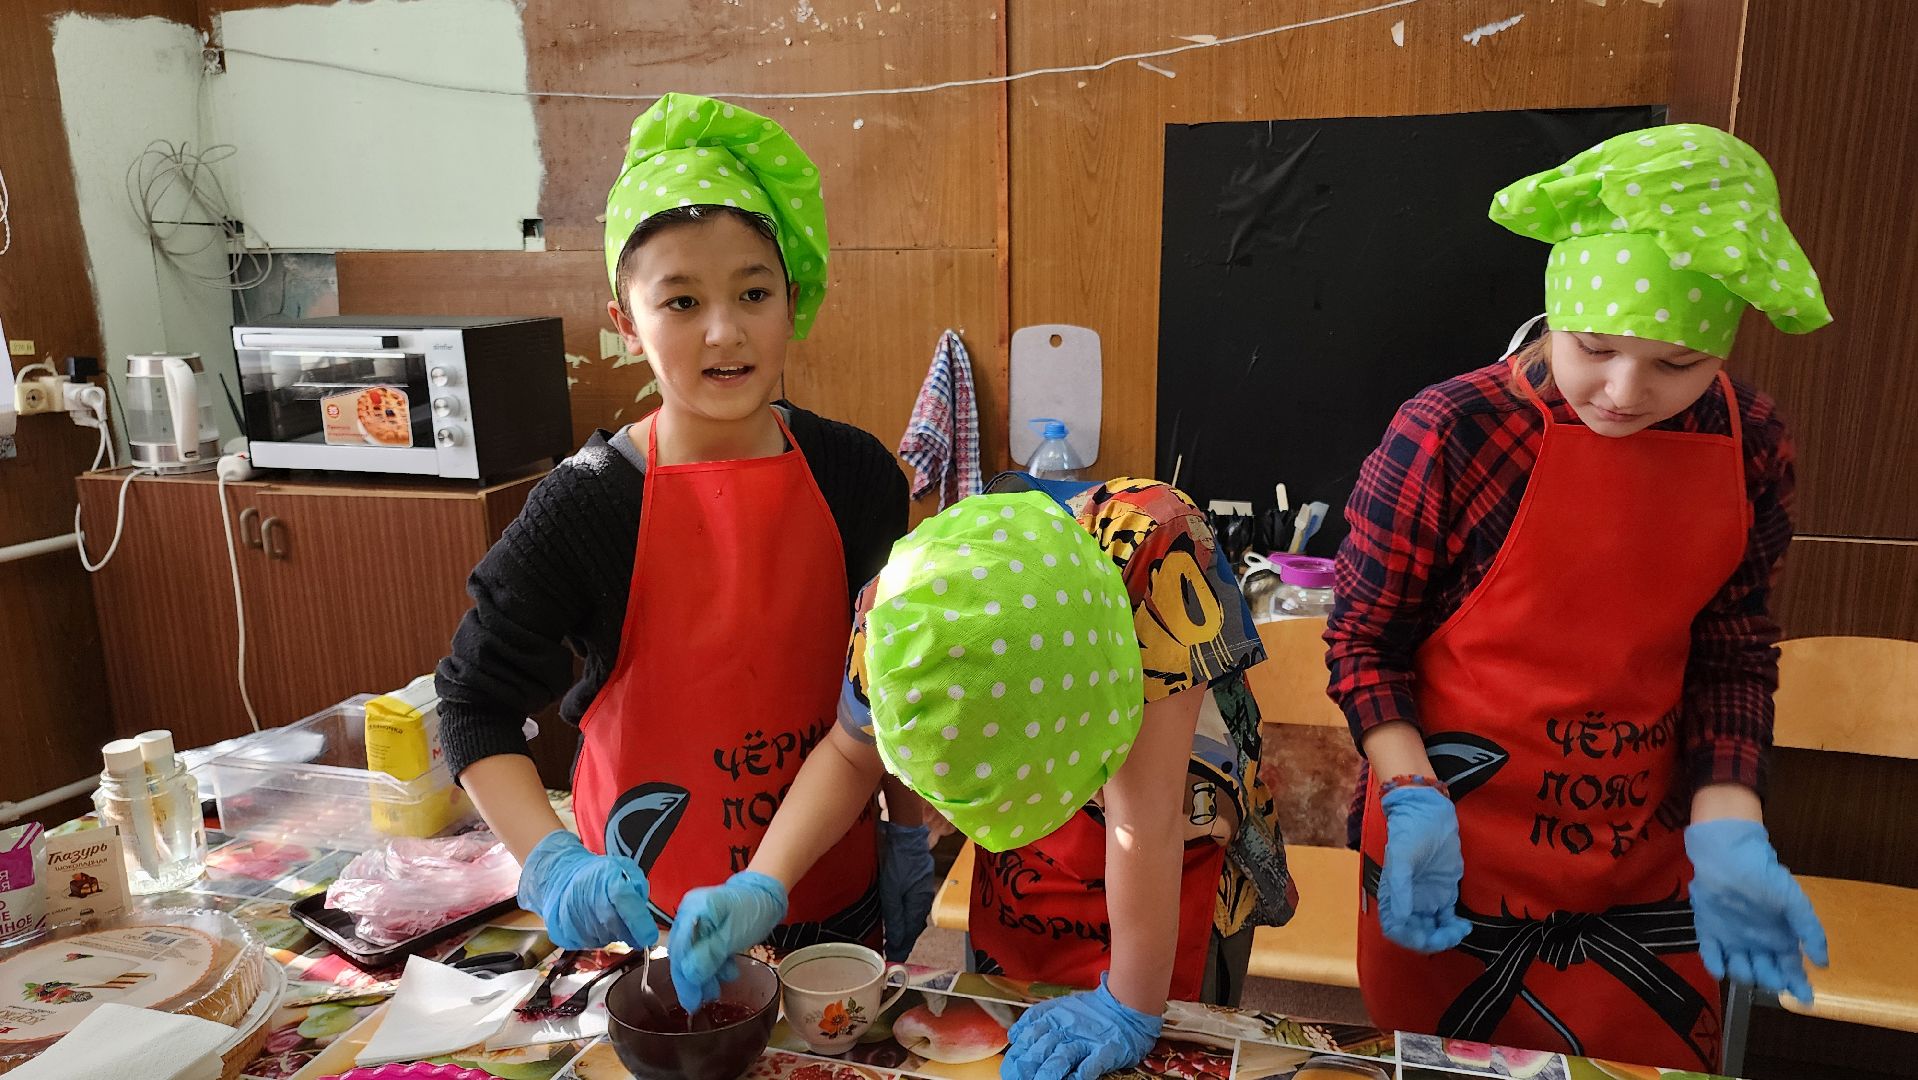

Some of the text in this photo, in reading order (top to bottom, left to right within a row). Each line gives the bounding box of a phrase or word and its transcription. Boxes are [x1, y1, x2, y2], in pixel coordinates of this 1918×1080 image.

[722, 783, 791, 830] ПО
[1537, 769, 1650, 811] ПОЯС
[48, 842, 108, 866] Глазурь
[1530, 812, 1650, 859] ПО Б
[998, 897, 1112, 952] БОРЩ
